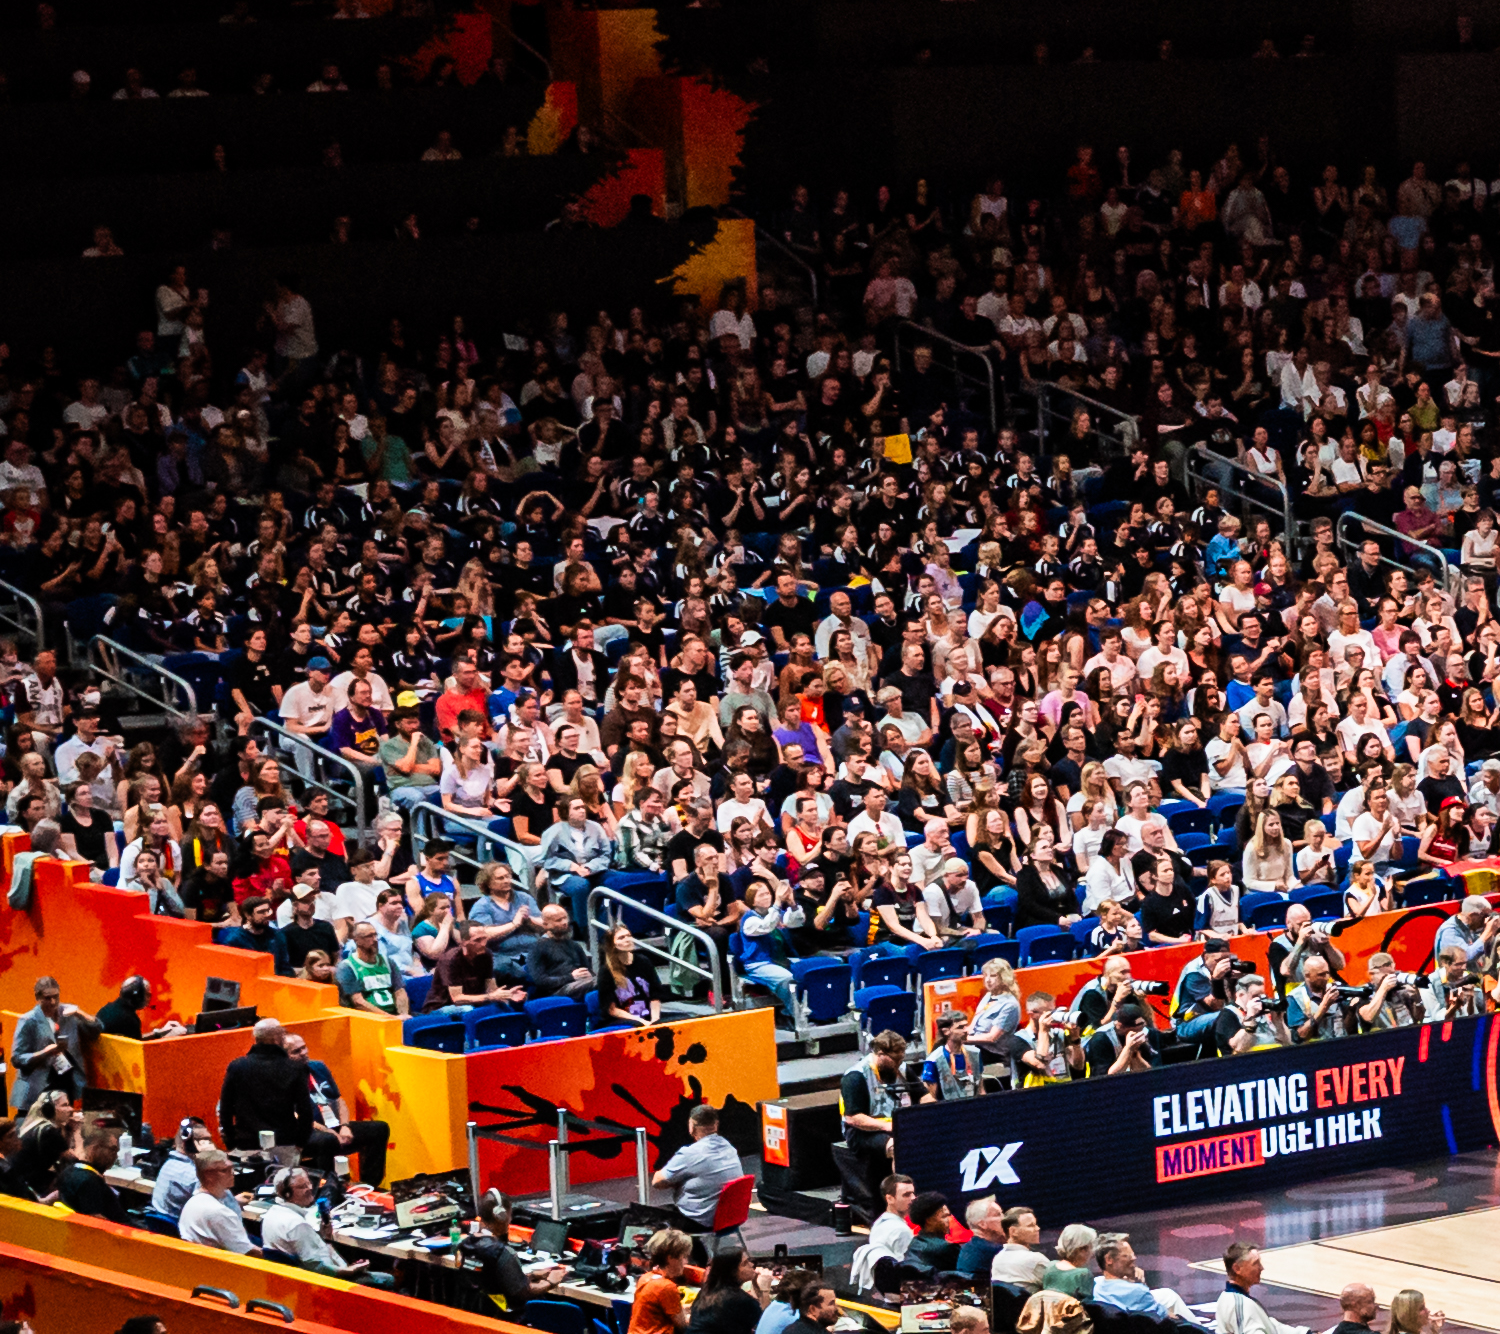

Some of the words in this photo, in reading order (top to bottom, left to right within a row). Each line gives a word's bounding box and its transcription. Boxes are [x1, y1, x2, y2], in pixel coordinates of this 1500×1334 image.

[1153, 1073, 1309, 1137] ELEVATING
[1315, 1056, 1405, 1109] EVERY
[959, 1141, 1024, 1192] 1X
[1163, 1134, 1257, 1178] MOMENT
